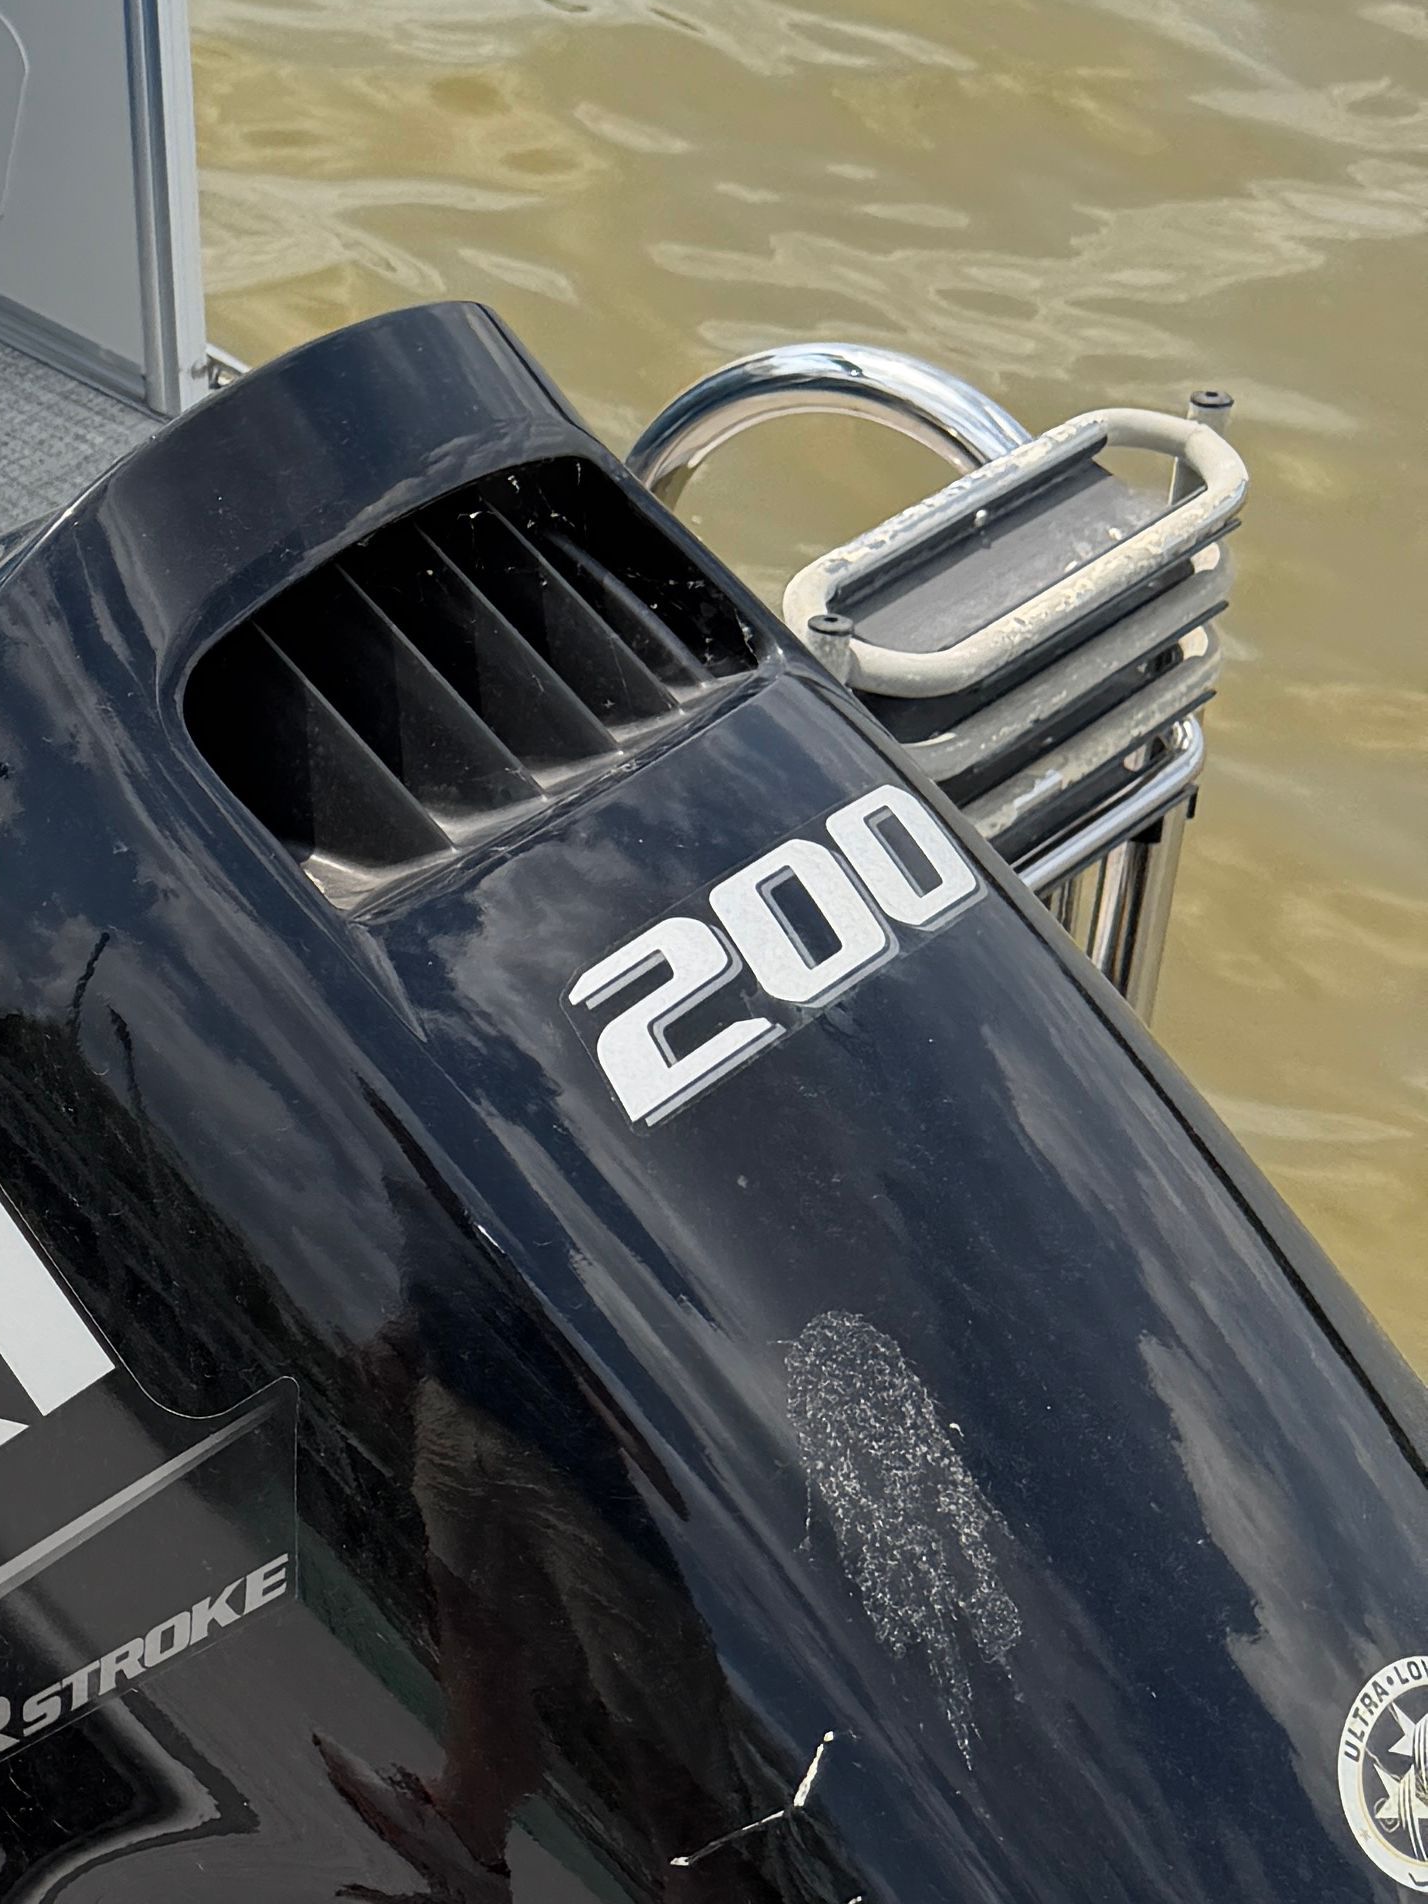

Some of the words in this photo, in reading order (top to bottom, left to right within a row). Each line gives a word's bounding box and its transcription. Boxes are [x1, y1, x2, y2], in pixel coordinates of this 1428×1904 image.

[568, 783, 987, 1127] 200
[22, 1552, 290, 1737] STROKE
[1344, 1679, 1390, 1763] ULTRA
[1393, 1658, 1428, 1685] LO
